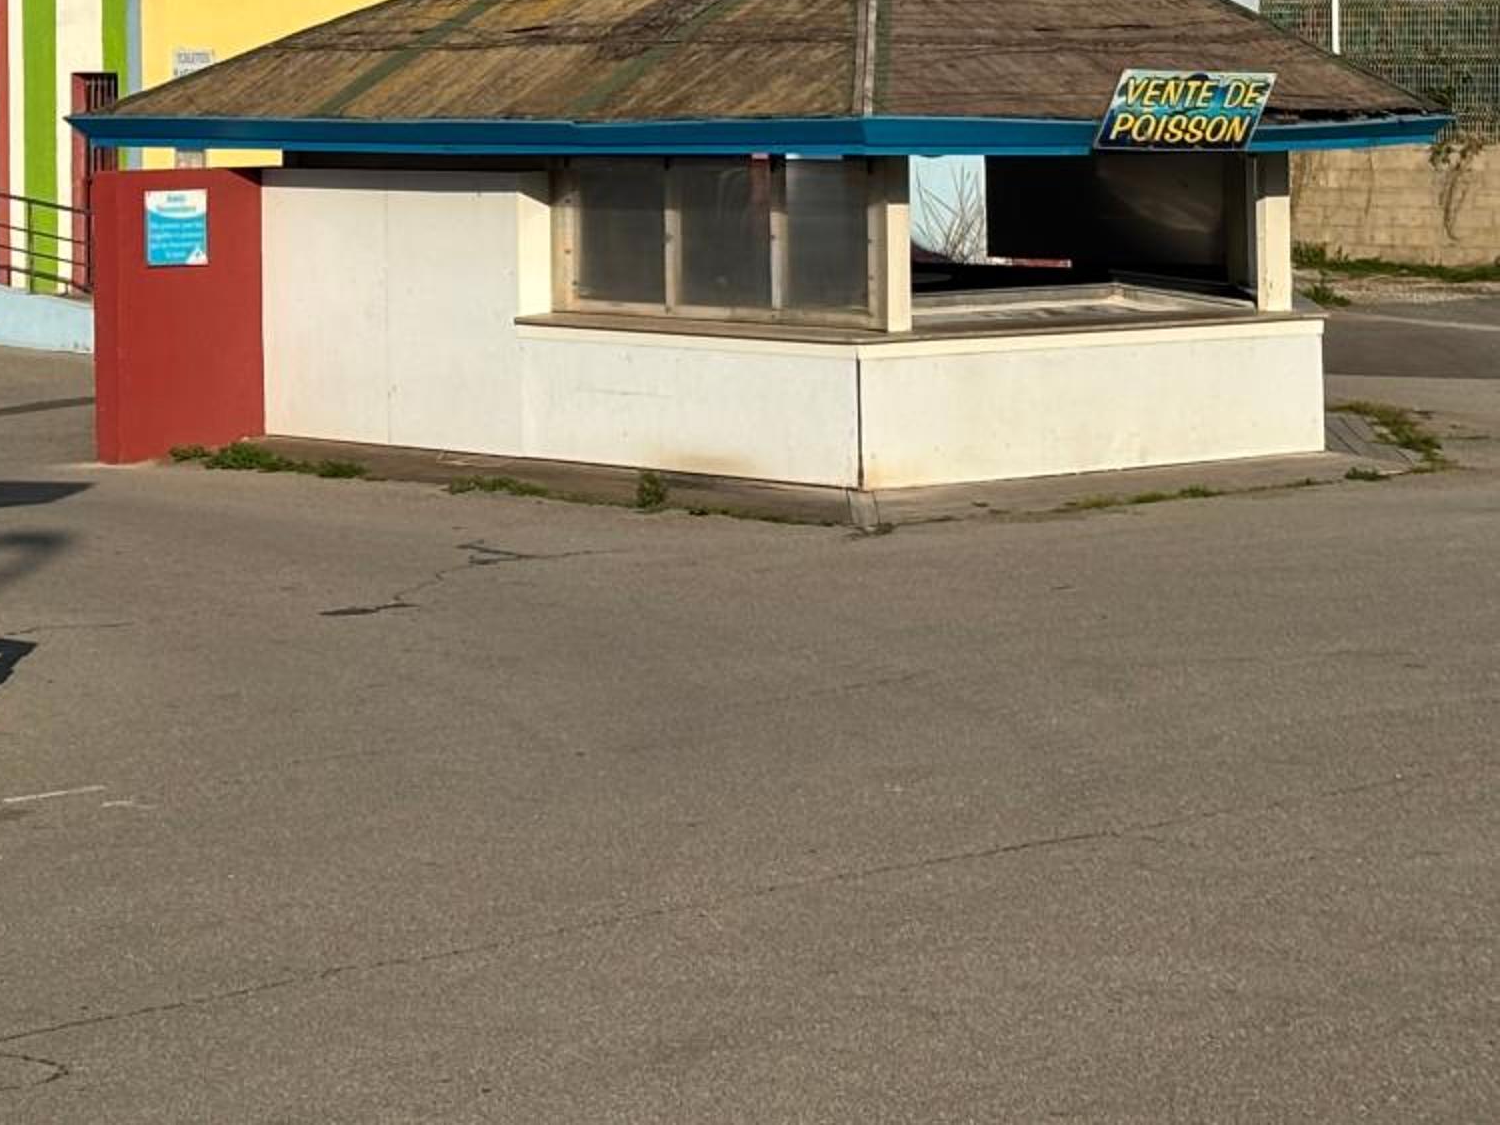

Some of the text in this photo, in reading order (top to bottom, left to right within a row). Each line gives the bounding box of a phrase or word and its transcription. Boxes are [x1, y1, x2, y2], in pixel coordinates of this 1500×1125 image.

[1125, 77, 1268, 109] VENTE DE
[1108, 112, 1251, 143] POISSON
